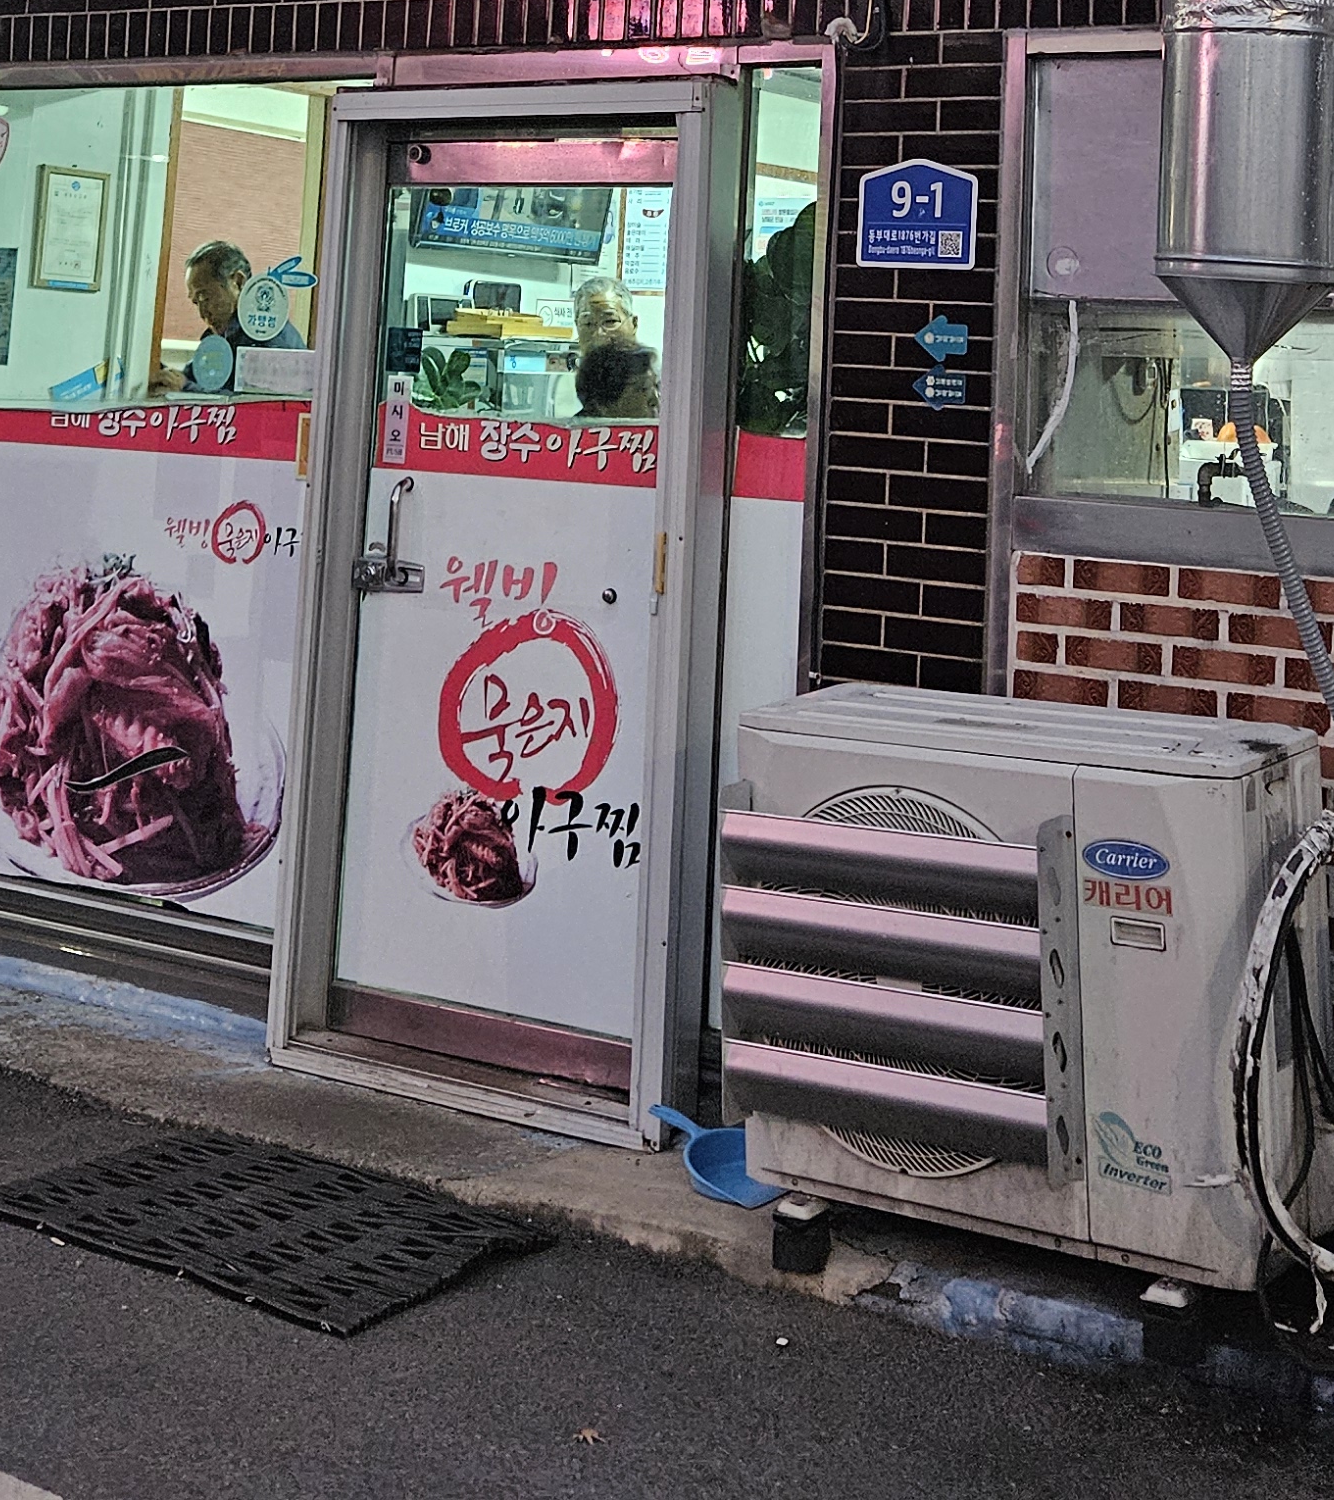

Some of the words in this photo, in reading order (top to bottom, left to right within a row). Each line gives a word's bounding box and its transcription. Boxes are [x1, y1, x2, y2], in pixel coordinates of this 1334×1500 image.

[891, 180, 943, 219] 9-1
[247, 313, 276, 328] 가맹점
[420, 422, 470, 452] 남해
[164, 517, 210, 549] 웰빙
[217, 522, 259, 559] 묵은지
[263, 526, 304, 558] 아구
[440, 556, 558, 634] 웰빙
[461, 674, 589, 782] 묵은지
[501, 786, 641, 869] 아구찜
[1095, 848, 1157, 869] Carrier
[1084, 879, 1173, 915] 캐리어
[1133, 1141, 1162, 1160] ECO
[1136, 1156, 1169, 1173] Green
[1104, 1163, 1167, 1191] Inverter
